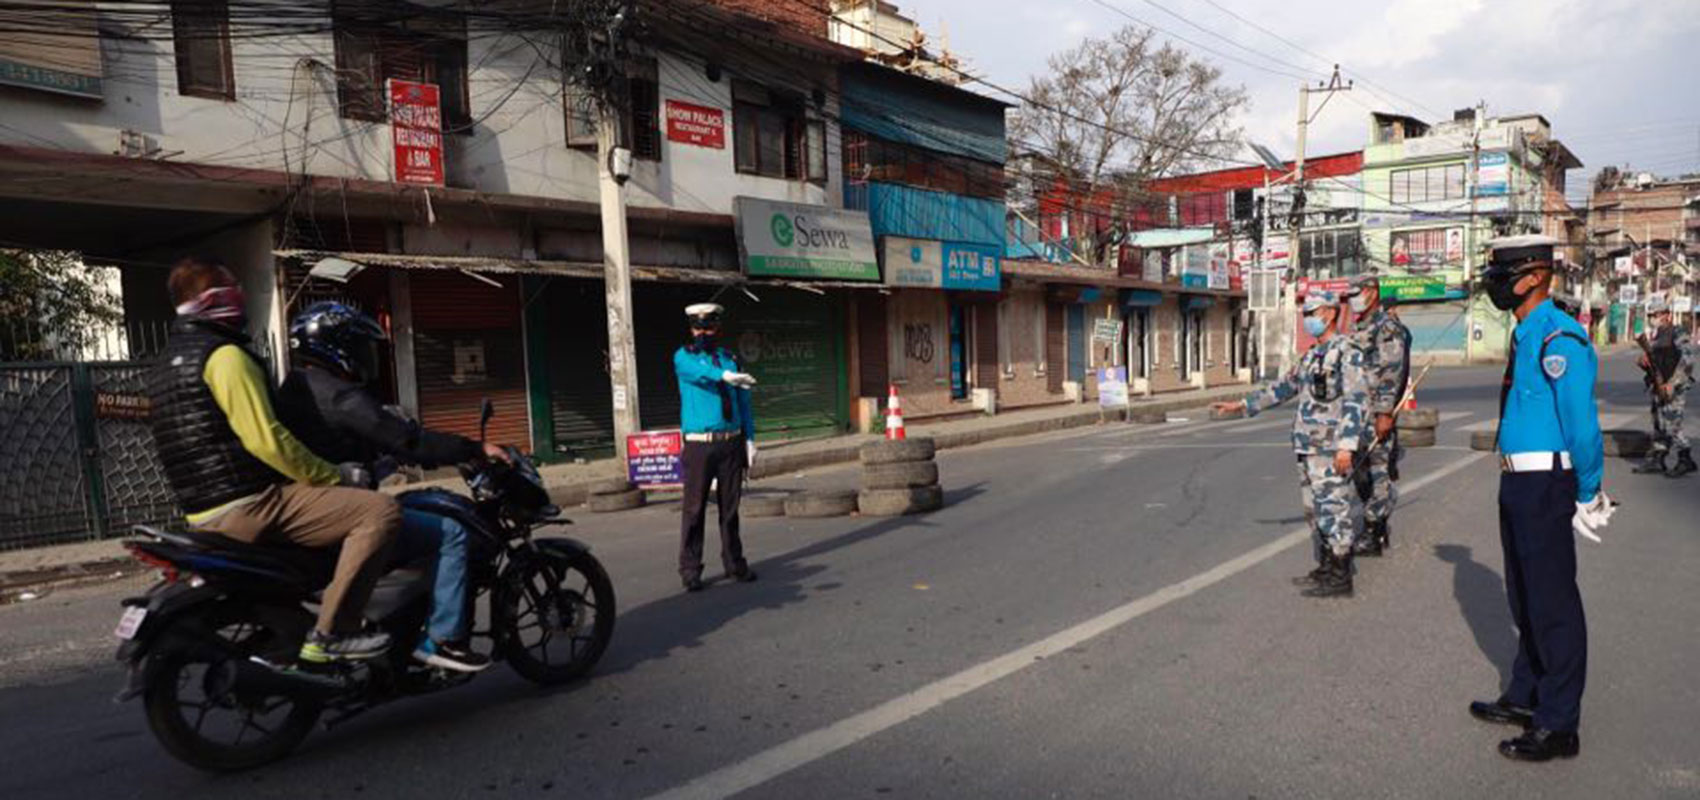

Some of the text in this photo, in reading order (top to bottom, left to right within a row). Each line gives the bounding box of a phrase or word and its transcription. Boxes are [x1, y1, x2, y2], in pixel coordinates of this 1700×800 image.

[667, 106, 722, 127] SHOW PALACE
[396, 128, 438, 148] RESTAURANT
[414, 150, 431, 167] BAR
[948, 248, 979, 269] ATM
[97, 392, 115, 406] NO
